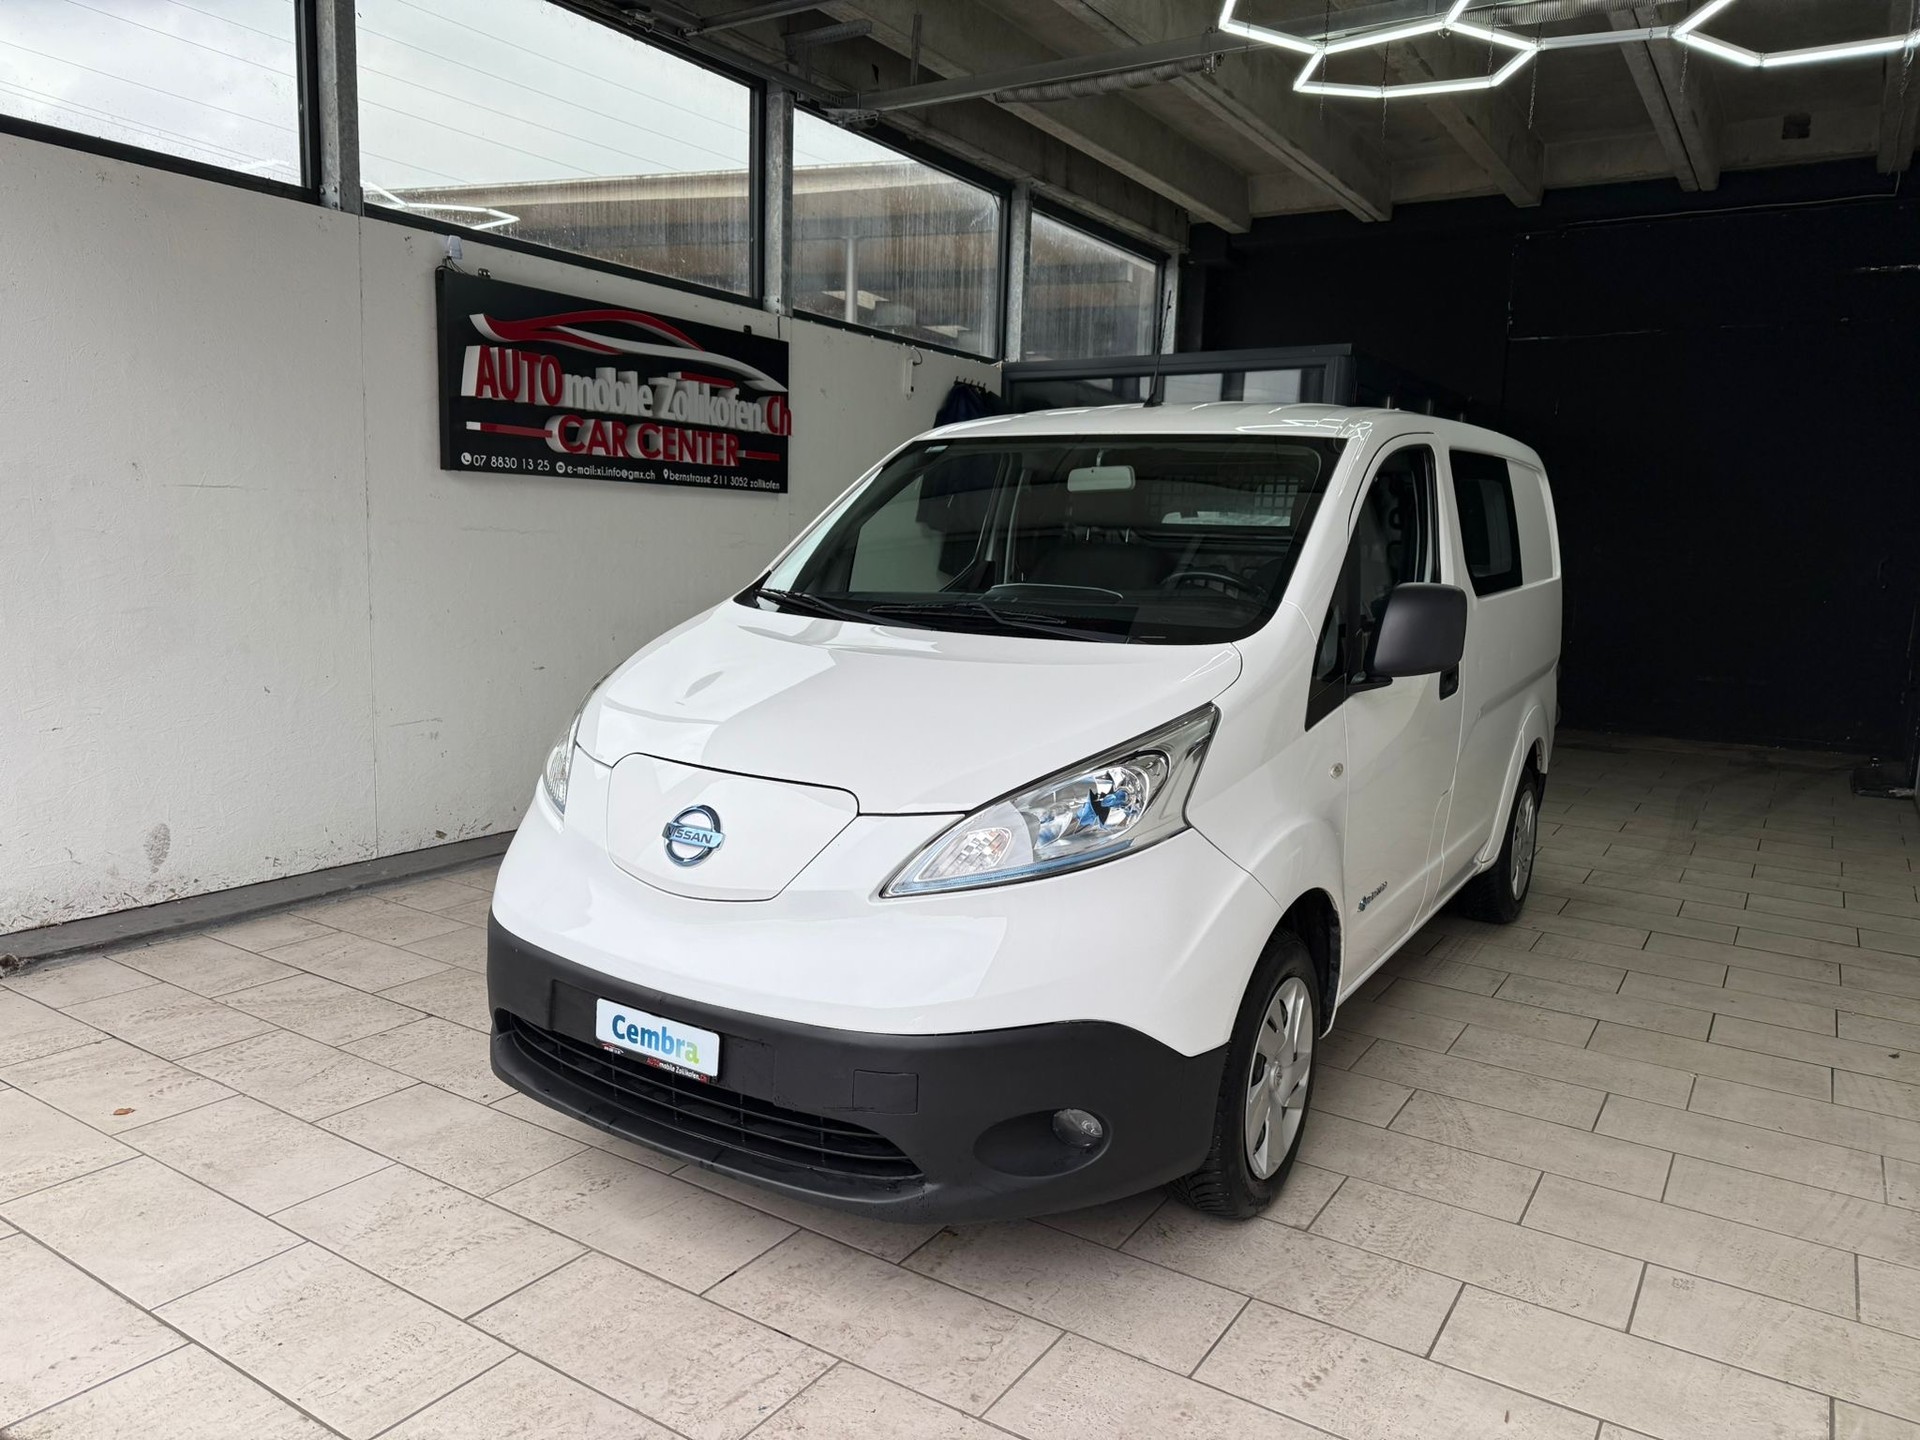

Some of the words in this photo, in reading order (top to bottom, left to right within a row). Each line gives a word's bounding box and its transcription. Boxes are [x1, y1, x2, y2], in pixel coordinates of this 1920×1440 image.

[463, 345, 653, 416] AUTOmobile
[550, 415, 630, 458] CAR
[633, 423, 740, 466] CENTER
[473, 454, 487, 468] 07
[490, 455, 518, 469] 8830
[522, 458, 534, 470] 13
[537, 459, 550, 471] 25
[669, 471, 712, 483] bernstrasse
[713, 474, 728, 485] 211
[730, 476, 748, 487] 3052
[750, 478, 780, 490] zollikofen
[665, 825, 713, 844] NISSAN
[612, 1014, 700, 1064] Cembra
